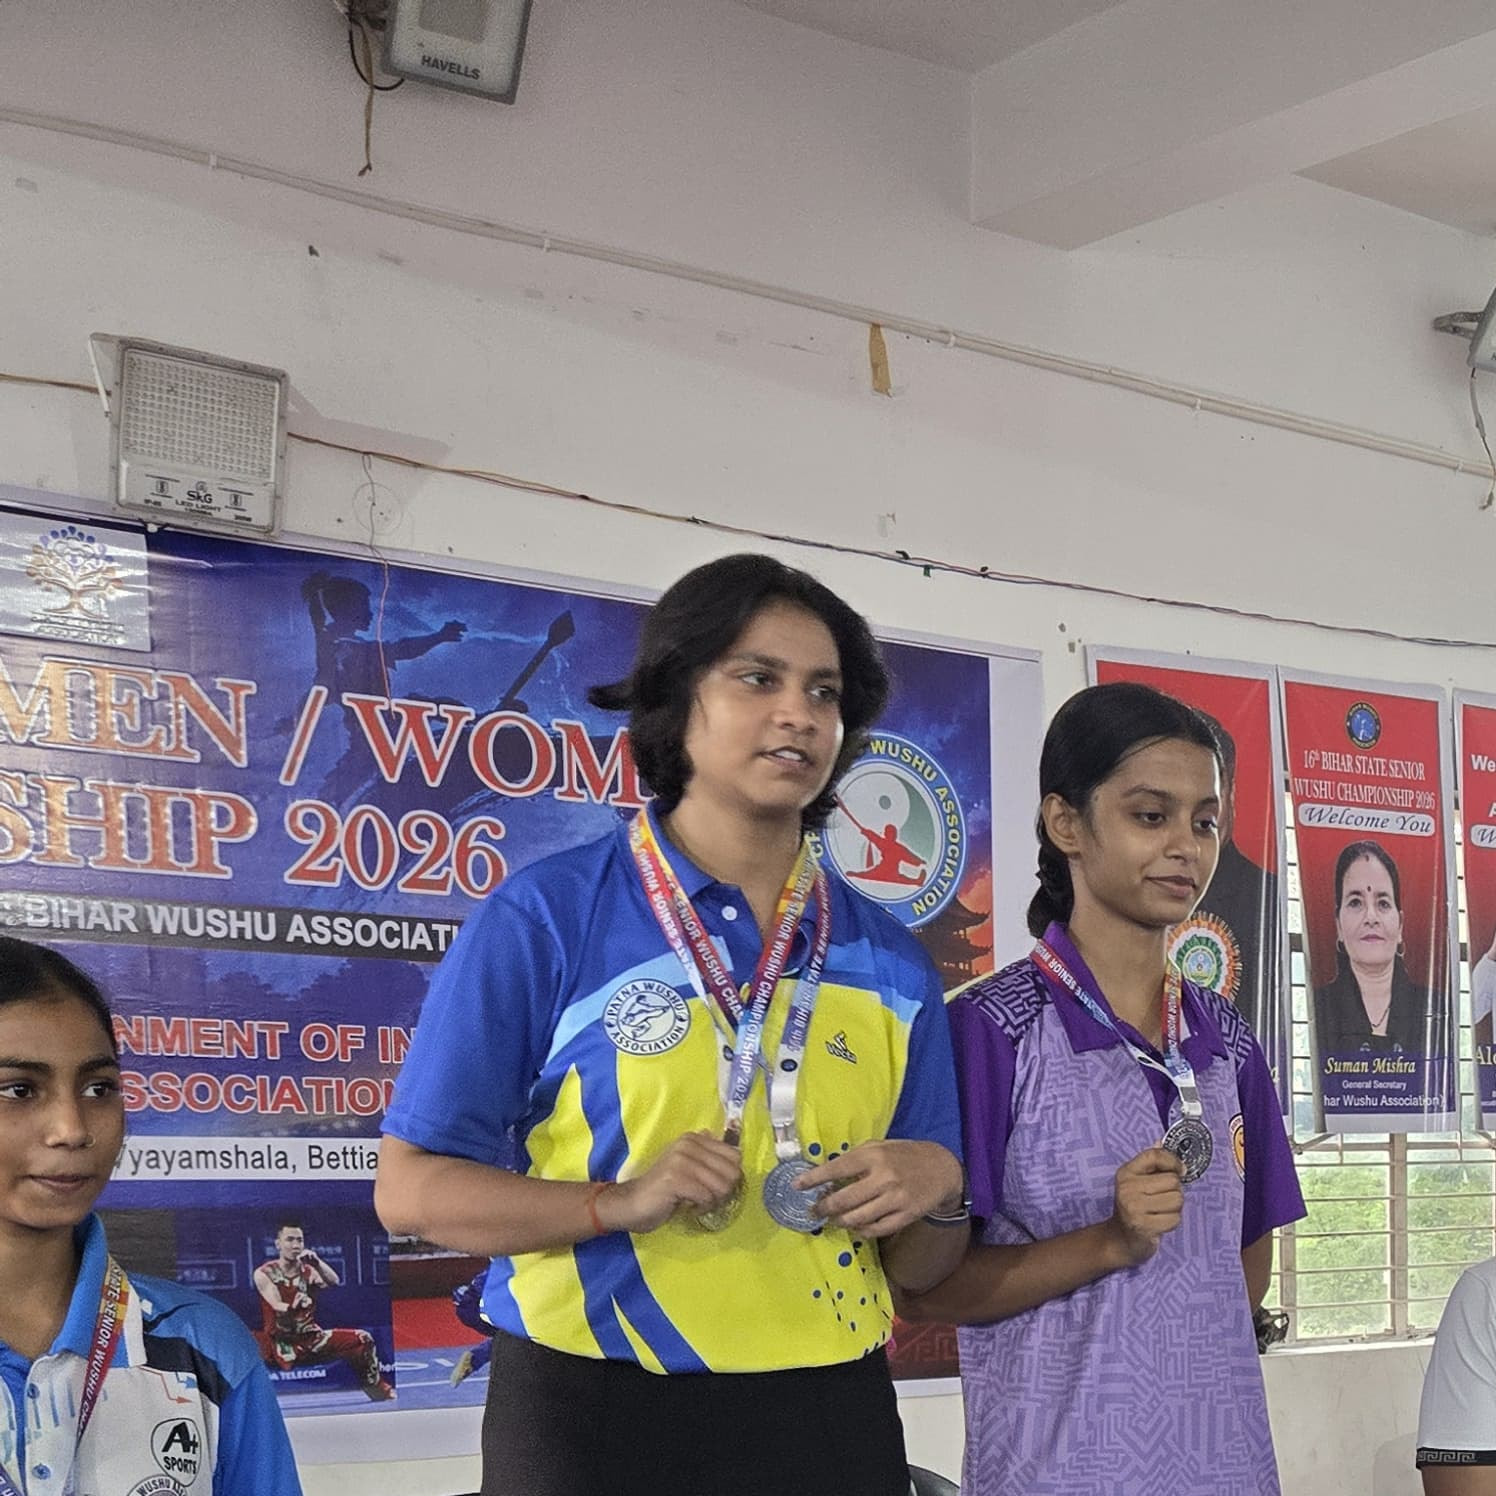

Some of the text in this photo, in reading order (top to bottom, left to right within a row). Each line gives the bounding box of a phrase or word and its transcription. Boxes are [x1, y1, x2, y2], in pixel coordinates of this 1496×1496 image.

[421, 55, 481, 80] HAVELLS
[280, 686, 328, 786] /
[1322, 751, 1353, 773] BIHAR
[1355, 756, 1387, 777] STATE
[1389, 760, 1426, 781] SENIOR
[1294, 777, 1335, 800] WUSHU
[1337, 783, 1414, 808] CHAMPIONSHIP
[870, 740, 961, 916] WUSHU ASSOCIATION
[1304, 806, 1432, 833] Welcome You
[284, 800, 508, 898] 2026
[24, 898, 139, 933] BIHAR
[144, 904, 275, 940] WUSHU
[695, 934, 728, 987] WUSHU
[763, 937, 788, 982] WUSHU
[1049, 959, 1078, 992] SENIOR
[643, 982, 685, 1011] WUSHU
[301, 1022, 366, 1063] OF
[611, 1025, 685, 1052] ASSOCIATION
[739, 981, 774, 1075] CHAMPIONSHIP
[1324, 1056, 1416, 1074] Suman Mishra
[1342, 1080, 1407, 1091] General Secretary
[1343, 1095, 1378, 1107] Wushu
[98, 1300, 118, 1349] SENIOR
[85, 1348, 107, 1401] WUSHU
[161, 1421, 198, 1454] A+
[163, 1456, 197, 1474] SPORTS
[136, 1478, 170, 1496] WUSHU
